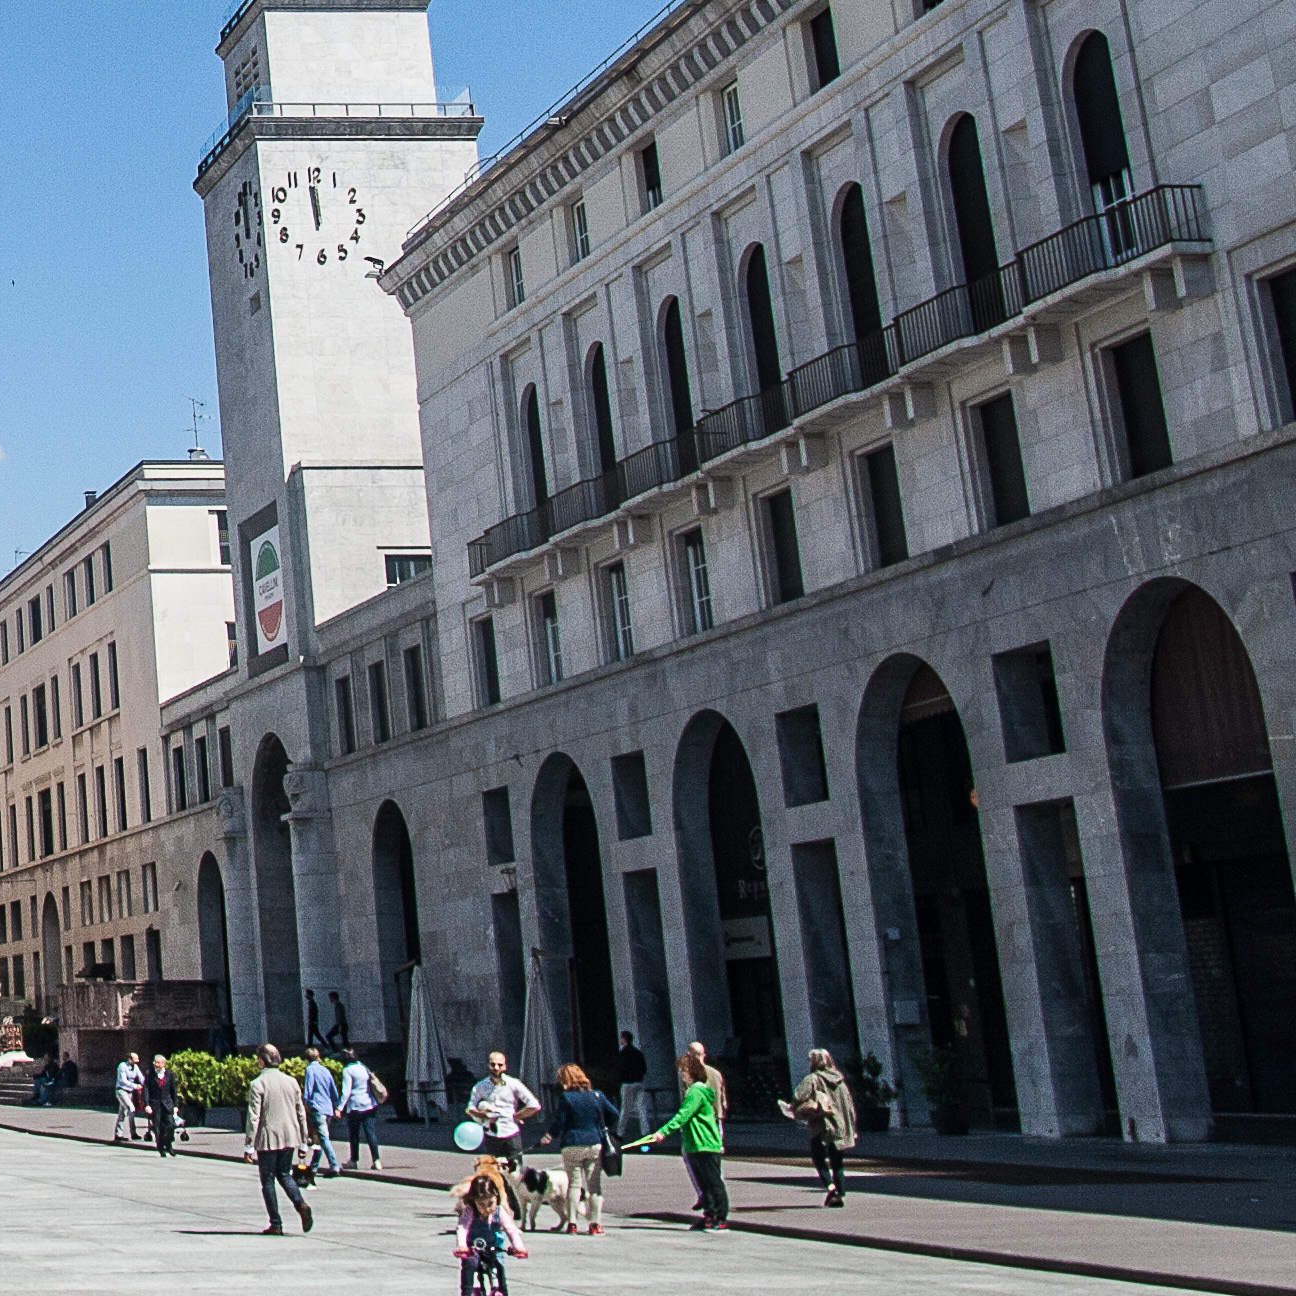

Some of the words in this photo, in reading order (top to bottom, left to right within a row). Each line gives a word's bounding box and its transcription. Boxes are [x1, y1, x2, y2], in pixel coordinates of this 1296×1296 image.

[288, 171, 298, 189] 11
[308, 167, 321, 184] 12
[332, 171, 337, 189] 1
[271, 187, 287, 204] 10
[348, 187, 357, 204] 2
[271, 208, 281, 225] 9
[355, 208, 366, 225] 3
[279, 226, 289, 244] 8
[349, 227, 361, 244] 4
[295, 243, 304, 262] 7
[316, 248, 327, 266] 6
[337, 244, 348, 261] 5
